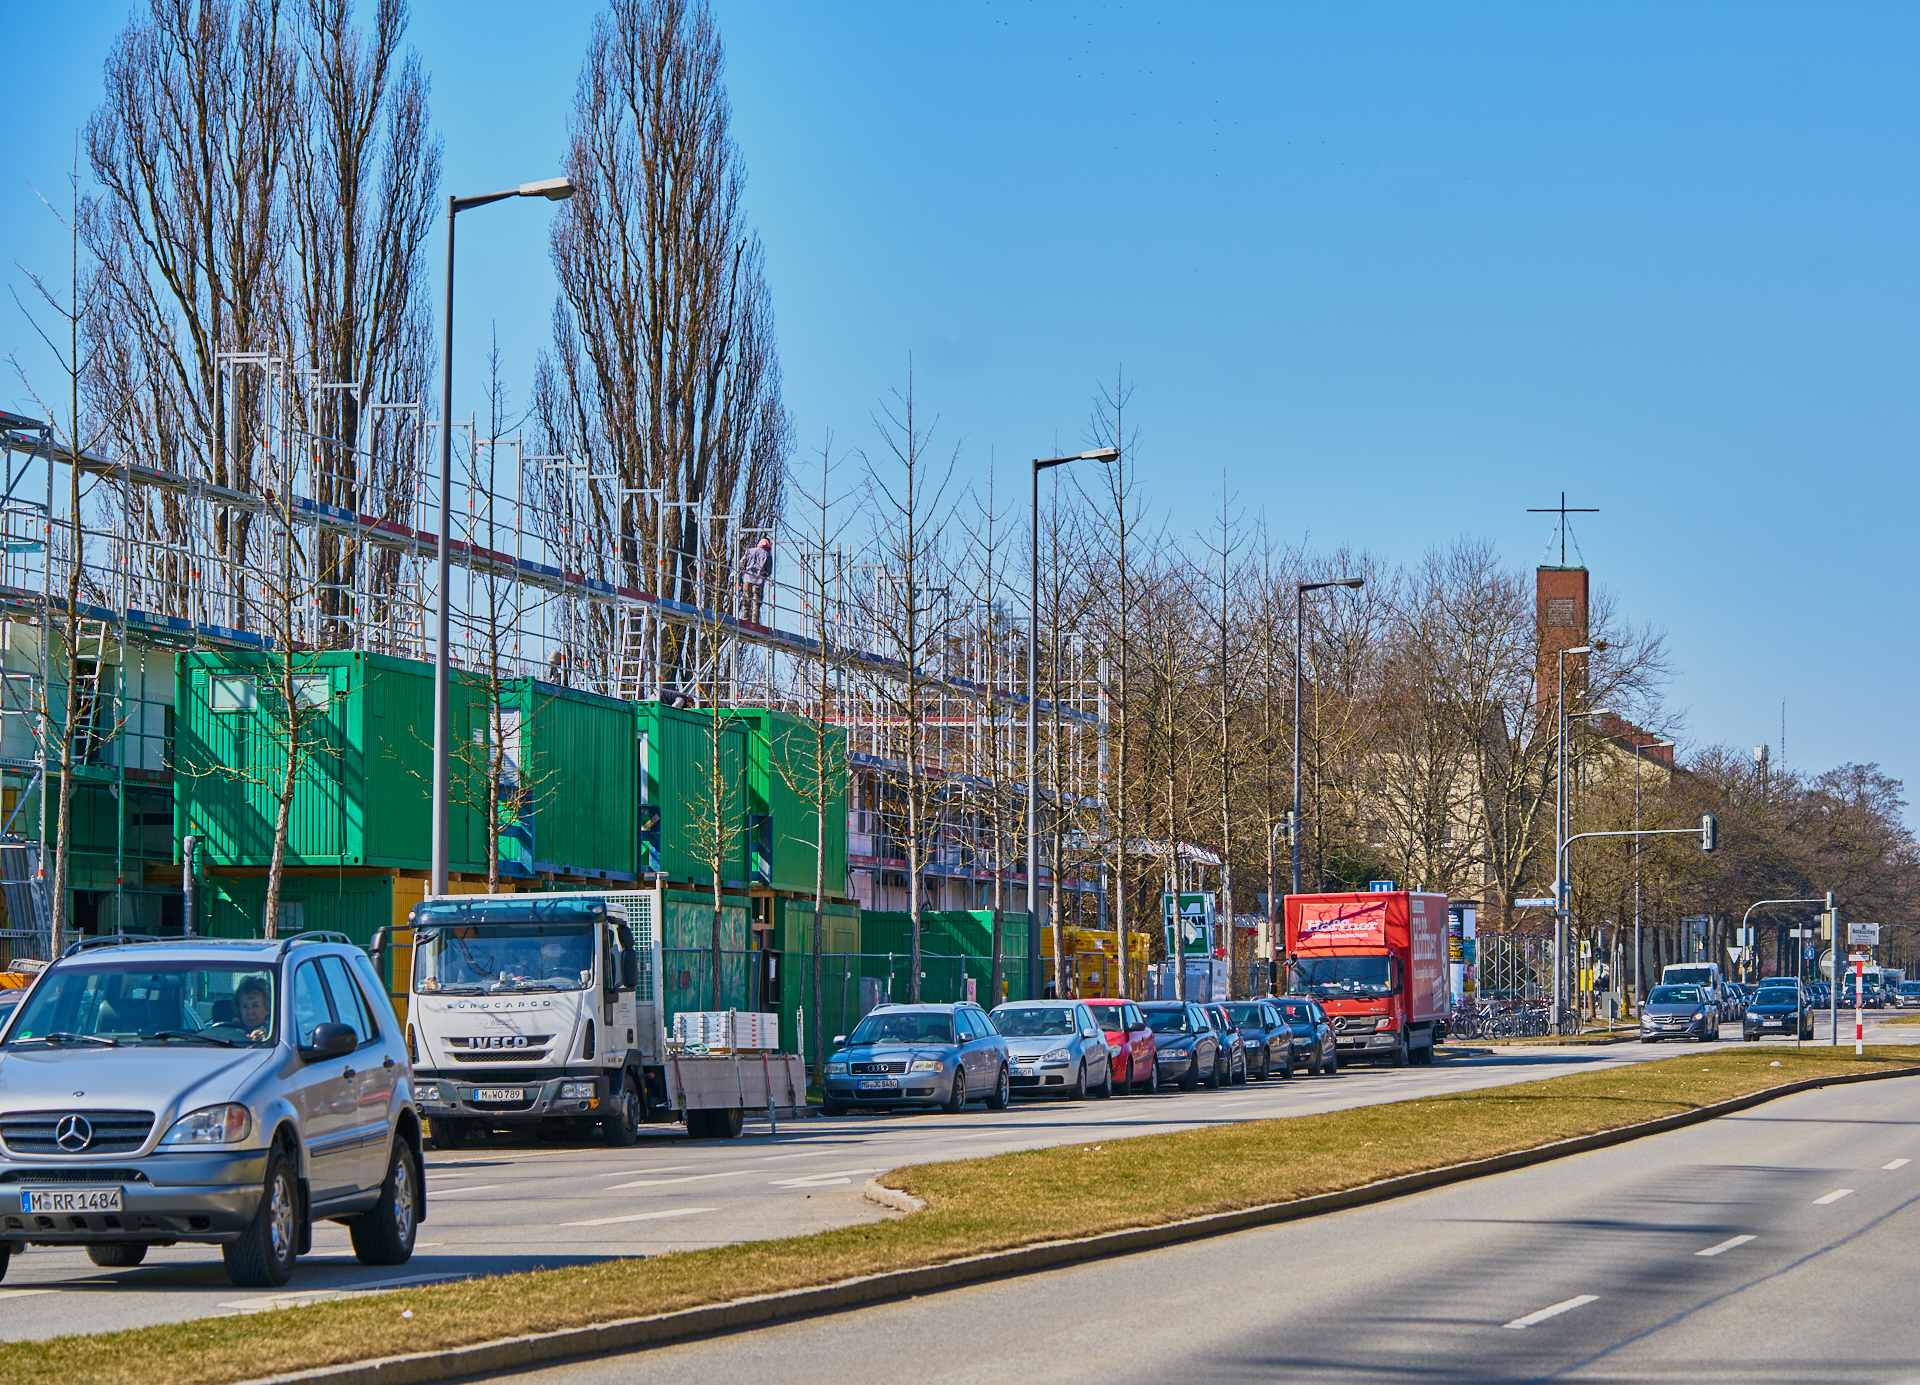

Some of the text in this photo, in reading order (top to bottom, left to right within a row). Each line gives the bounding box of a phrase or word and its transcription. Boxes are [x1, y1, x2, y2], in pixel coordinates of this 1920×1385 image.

[1305, 919, 1378, 932] Höffner
[447, 1000, 551, 1009] EUROCARGO
[468, 1036, 528, 1049] IVECO
[504, 1090, 520, 1099] 789
[31, 1194, 42, 1210] M
[53, 1194, 75, 1210] RR
[77, 1193, 118, 1210] 1484
